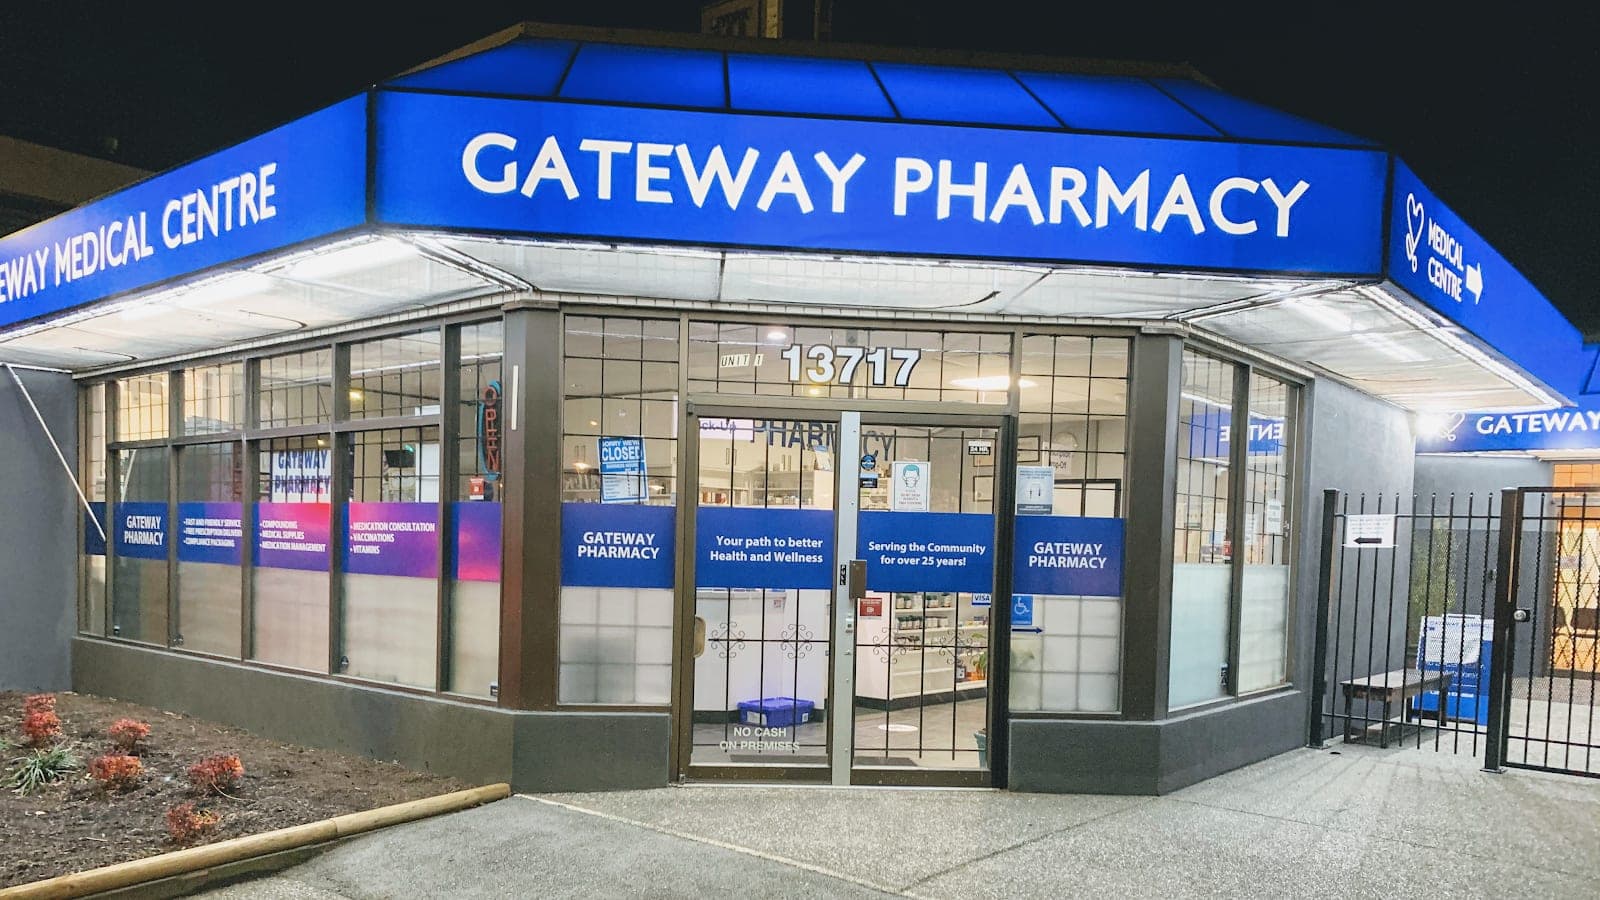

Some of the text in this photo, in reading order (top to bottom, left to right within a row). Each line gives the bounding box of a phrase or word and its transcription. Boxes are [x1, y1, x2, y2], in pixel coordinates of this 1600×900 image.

[462, 132, 1310, 237] GATEWAY PHARMACY
[55, 211, 153, 288] MEDICAL
[162, 162, 277, 249] CENTRE
[1428, 217, 1464, 271] MEDICAL
[1428, 257, 1462, 303] CENTRE
[720, 353, 764, 368] UNIT 1
[781, 343, 922, 387] 13717
[483, 386, 500, 472] OPEN
[1476, 411, 1600, 434] GATEWAY
[279, 449, 328, 469] GATEWAY
[275, 475, 331, 495] PHARMACY
[127, 515, 161, 529] GATEWAY
[353, 522, 435, 532] MEDICATION CONSULTATION
[124, 531, 163, 545] PHARMACY
[262, 530, 304, 539] MEDICAL SUPPLIES
[353, 533, 395, 543] VACCINATIONS
[583, 532, 655, 545] GATEWAY
[262, 541, 326, 552] MEDICATION MANAGEMENT
[716, 535, 823, 549] Your path to better
[868, 541, 986, 555] Serving the Community
[1034, 542, 1103, 555] GATEWAY
[353, 545, 380, 555] VITAMINS
[577, 545, 660, 559] PHARMACY
[710, 550, 823, 563] Health and Wellness
[880, 555, 967, 568] for over 25 years!
[1028, 555, 1107, 569] PHARMACY
[733, 726, 787, 737] NO CASH
[719, 741, 800, 751] ON PREMISES
